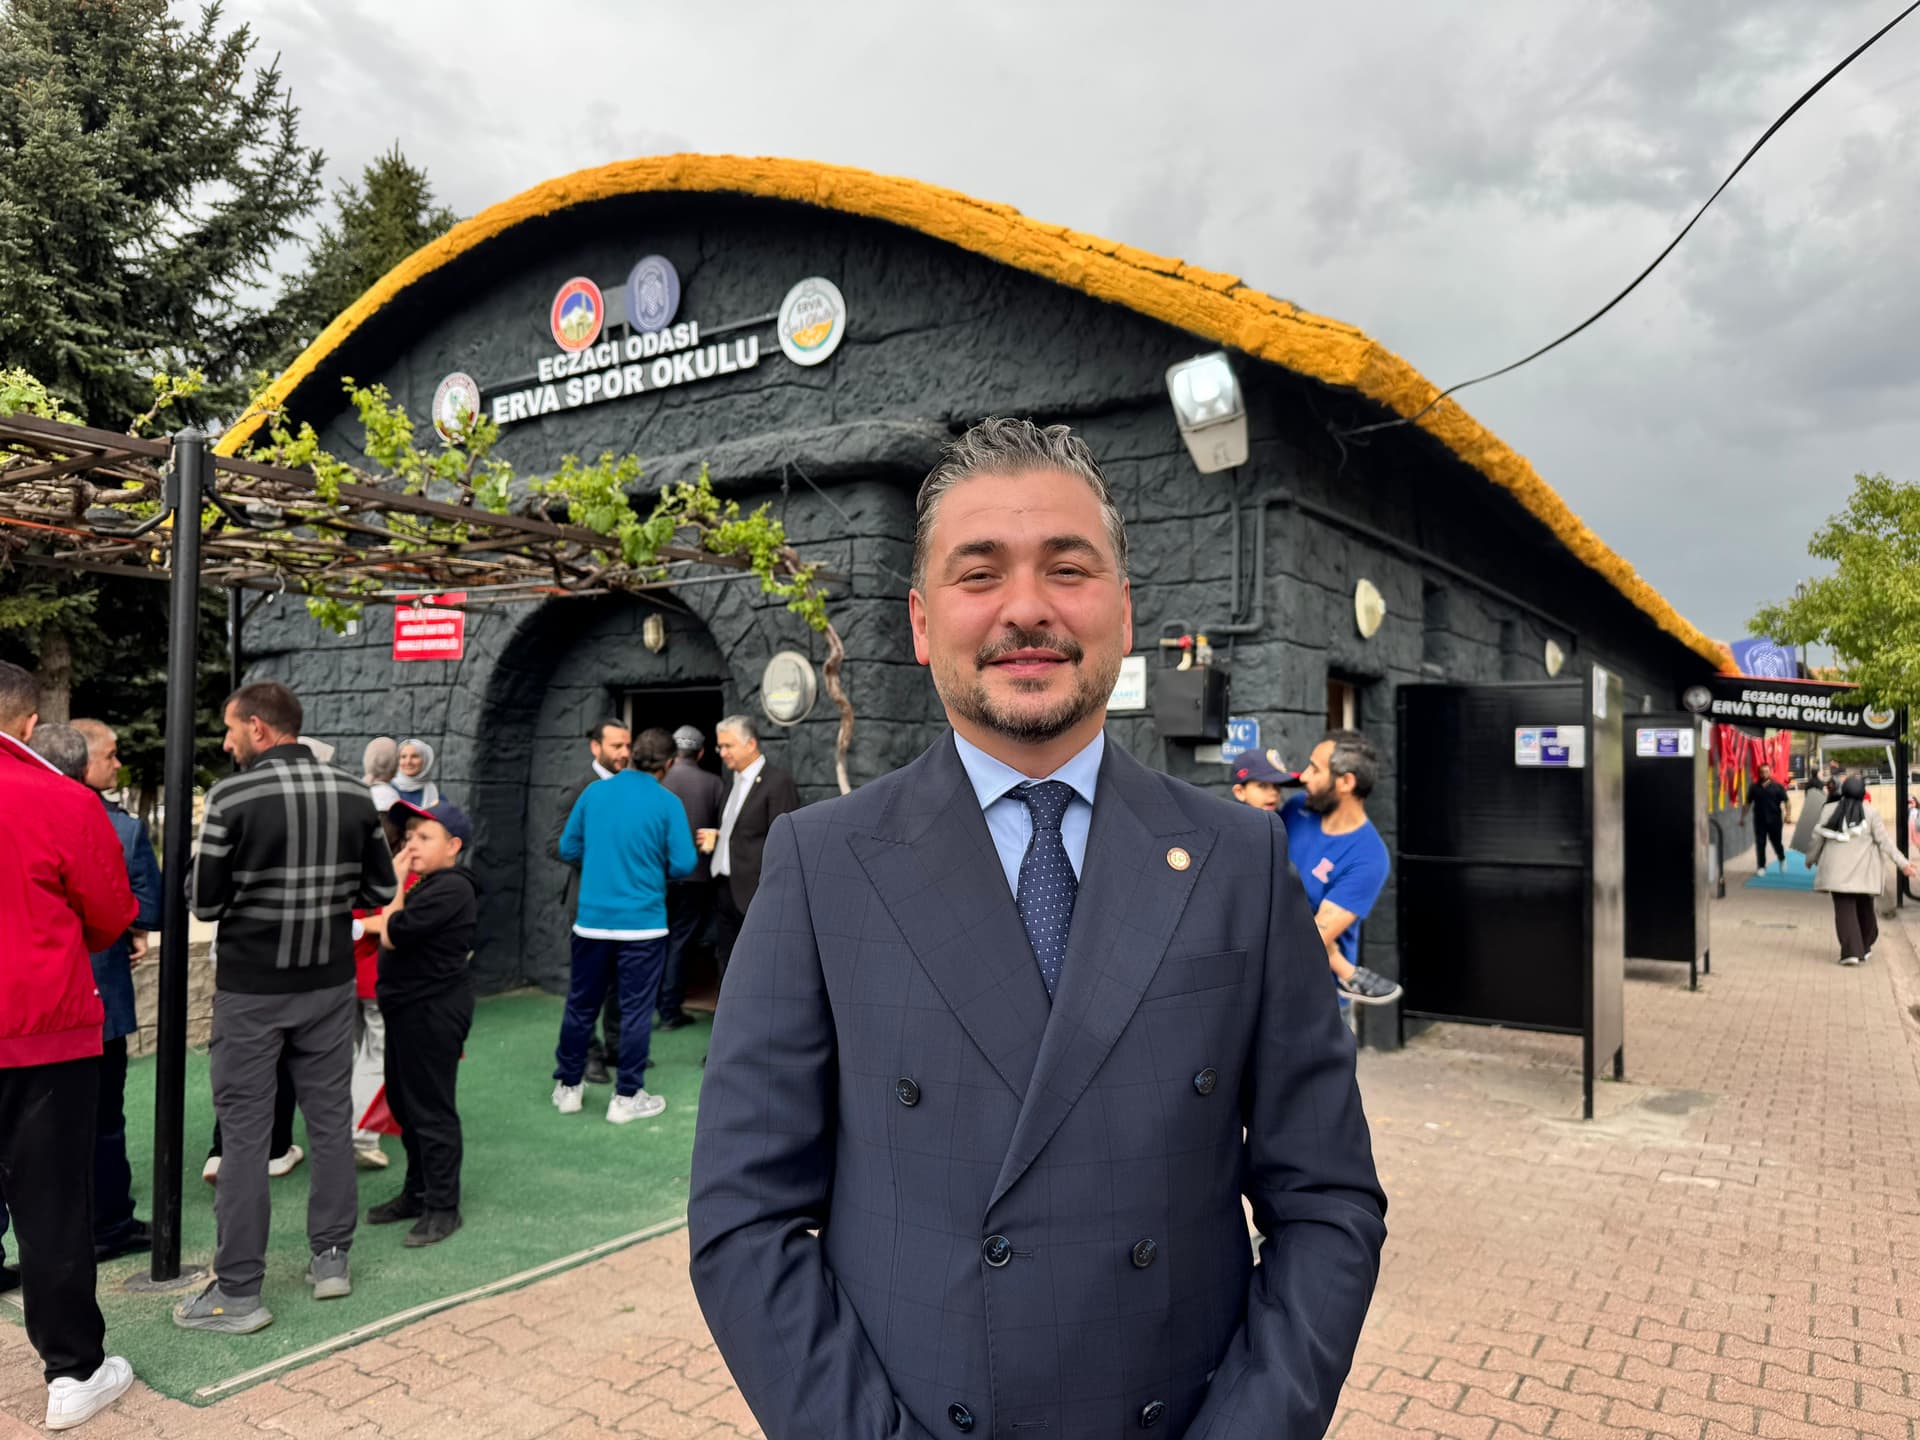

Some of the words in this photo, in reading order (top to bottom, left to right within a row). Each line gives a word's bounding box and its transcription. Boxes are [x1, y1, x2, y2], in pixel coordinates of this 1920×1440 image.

[538, 341, 620, 382] ECZACI
[625, 320, 699, 360] ODASI
[492, 384, 562, 424] ERVA
[565, 364, 645, 408] SPOR
[651, 335, 759, 388] OKULU
[1711, 700, 1752, 716] ERVA
[1755, 703, 1799, 720] SPOR
[1802, 707, 1859, 726] OKULU
[1791, 694, 1832, 709] ODASI
